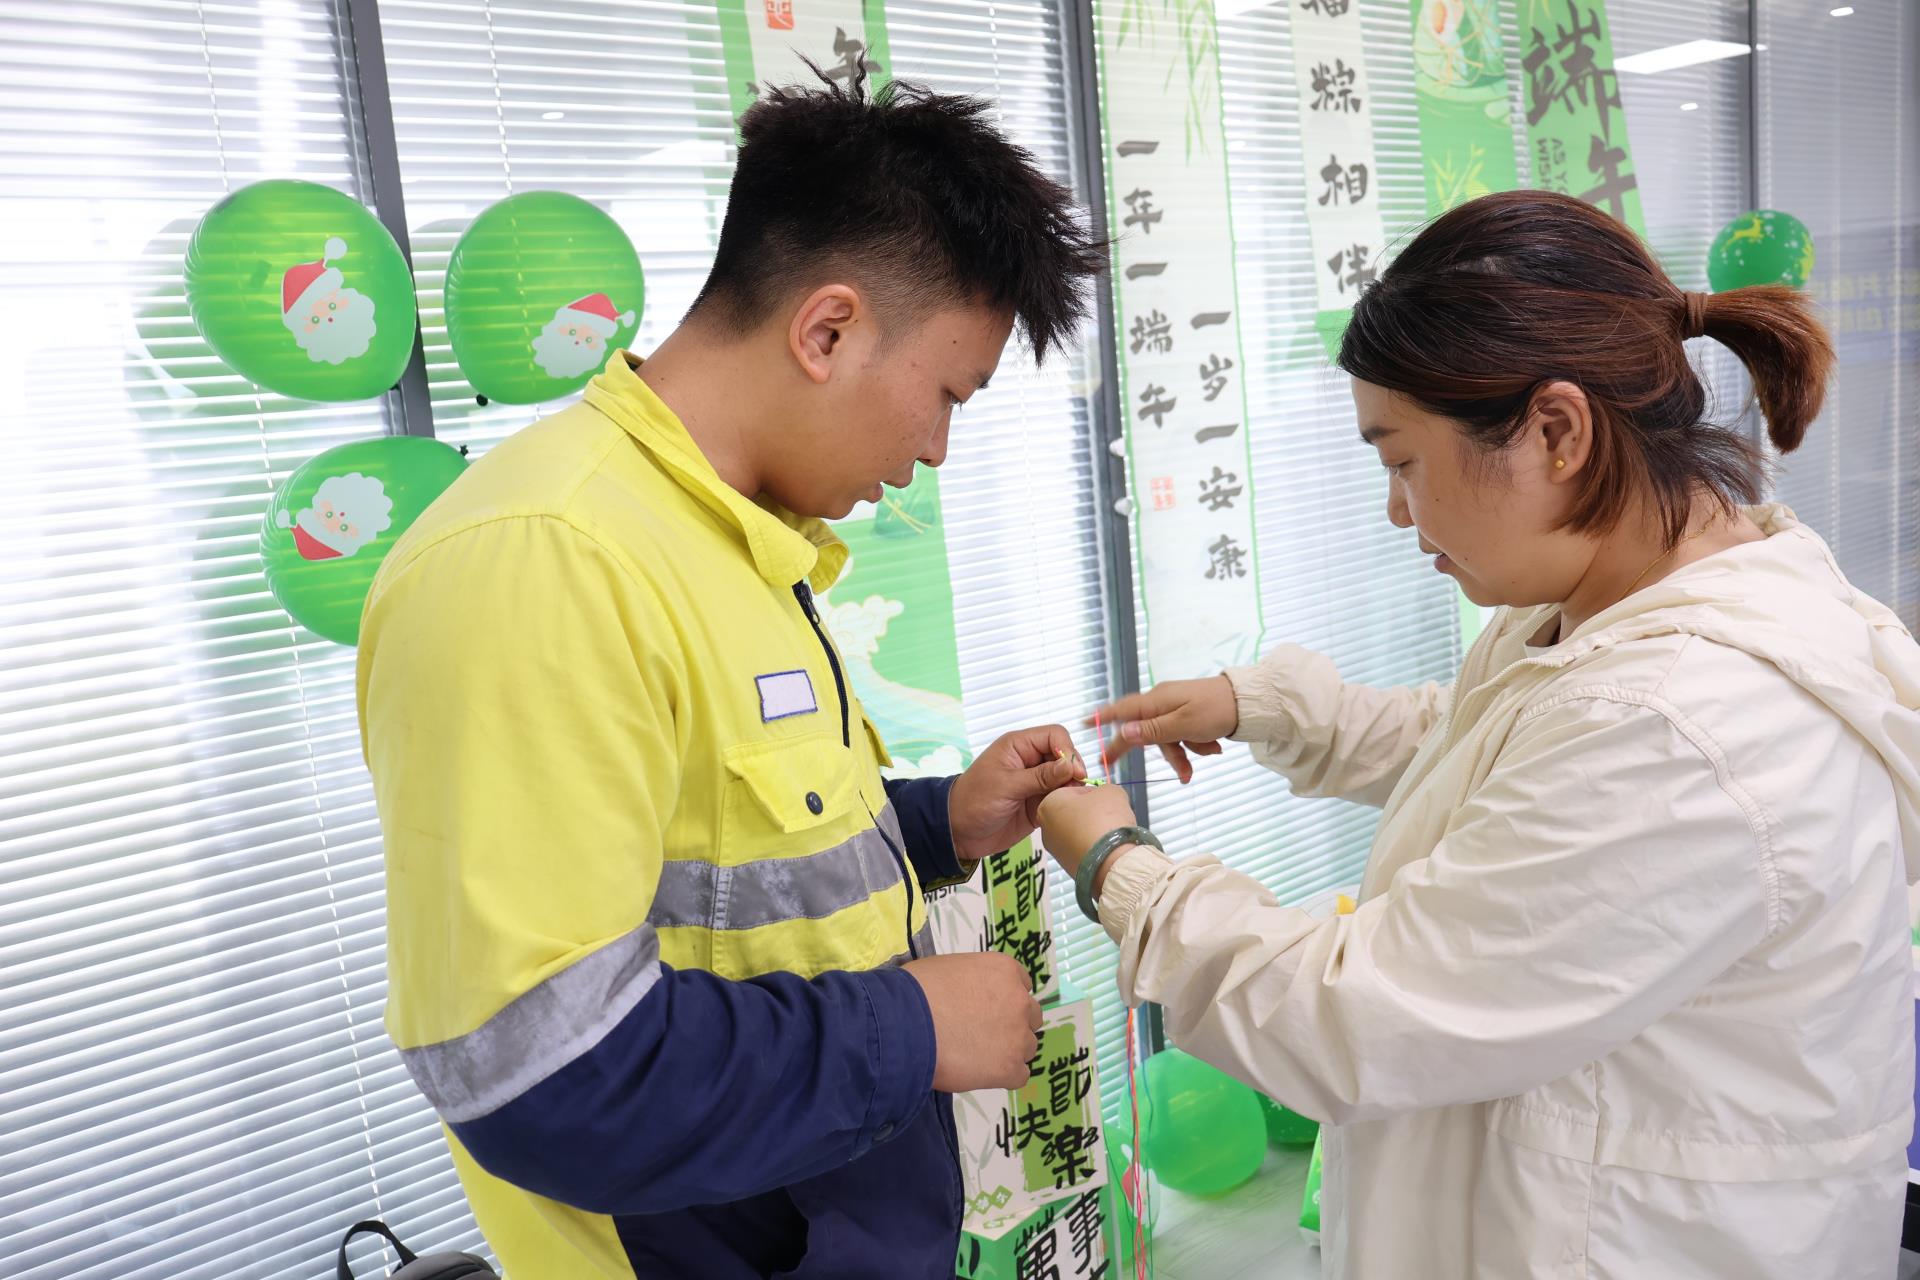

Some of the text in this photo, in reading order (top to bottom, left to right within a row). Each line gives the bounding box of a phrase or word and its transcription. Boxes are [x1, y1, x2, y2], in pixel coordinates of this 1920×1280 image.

[1115, 139, 1178, 429] 一年一端午
[1189, 309, 1250, 581] 一岁一安康
